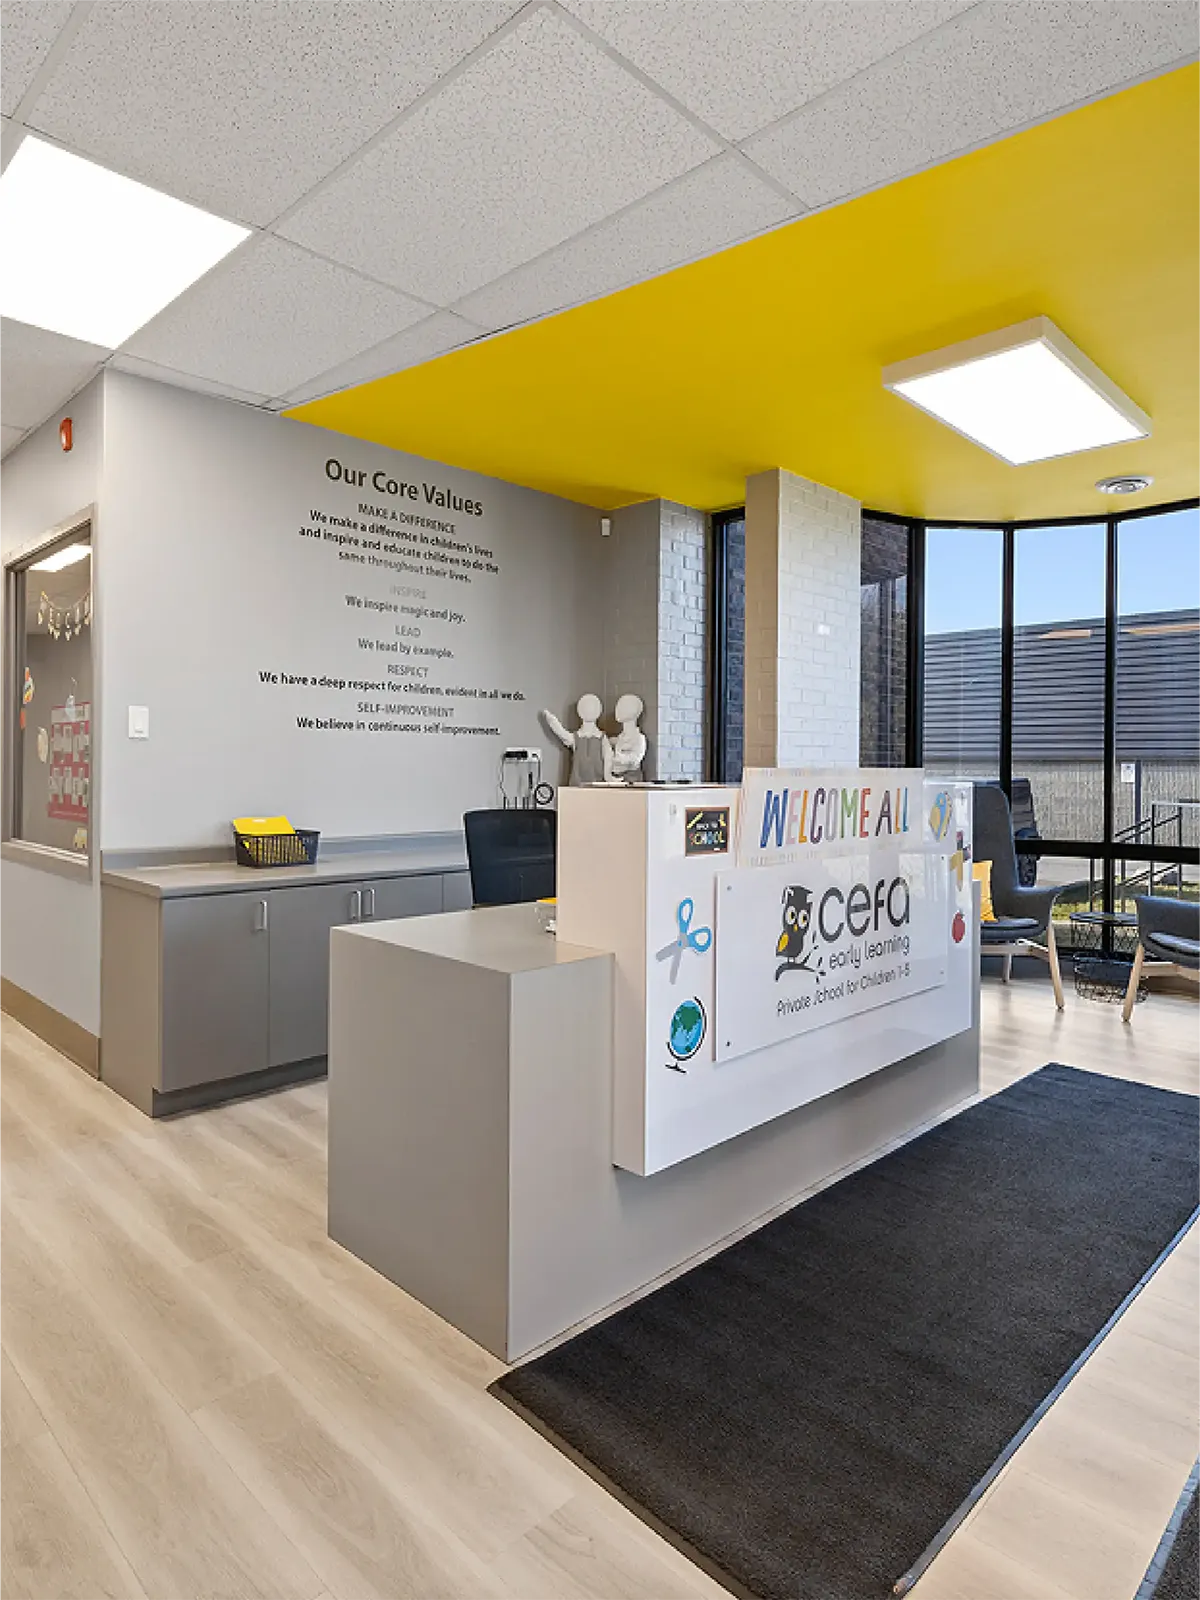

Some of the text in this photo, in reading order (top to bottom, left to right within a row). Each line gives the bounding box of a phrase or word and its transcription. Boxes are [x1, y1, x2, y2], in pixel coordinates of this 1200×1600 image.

[326, 459, 483, 516] Our Core Values
[310, 510, 493, 558] We make a difference in children's lives
[358, 504, 456, 533] MAKE A DIFFERENCE
[299, 526, 499, 574] and inspire and educate children to do the
[339, 552, 471, 583] same throughout their lives.
[346, 595, 466, 624] We inspire magic and joy.
[395, 625, 420, 637] LEAD
[358, 638, 454, 659] We lead by example.
[260, 671, 526, 700] We have a deep respect for children, evident in all we do.
[388, 664, 428, 678] RESPECT
[297, 718, 314, 730] We
[316, 718, 354, 731] believe
[357, 720, 365, 730] in
[368, 720, 420, 732] continuous
[760, 787, 909, 848] WELCOME ALL
[818, 876, 910, 942] cefa
[829, 935, 910, 970] early learning
[777, 993, 811, 1017] Private
[813, 981, 844, 1006] School
[846, 978, 859, 995] for
[861, 969, 895, 991] Children
